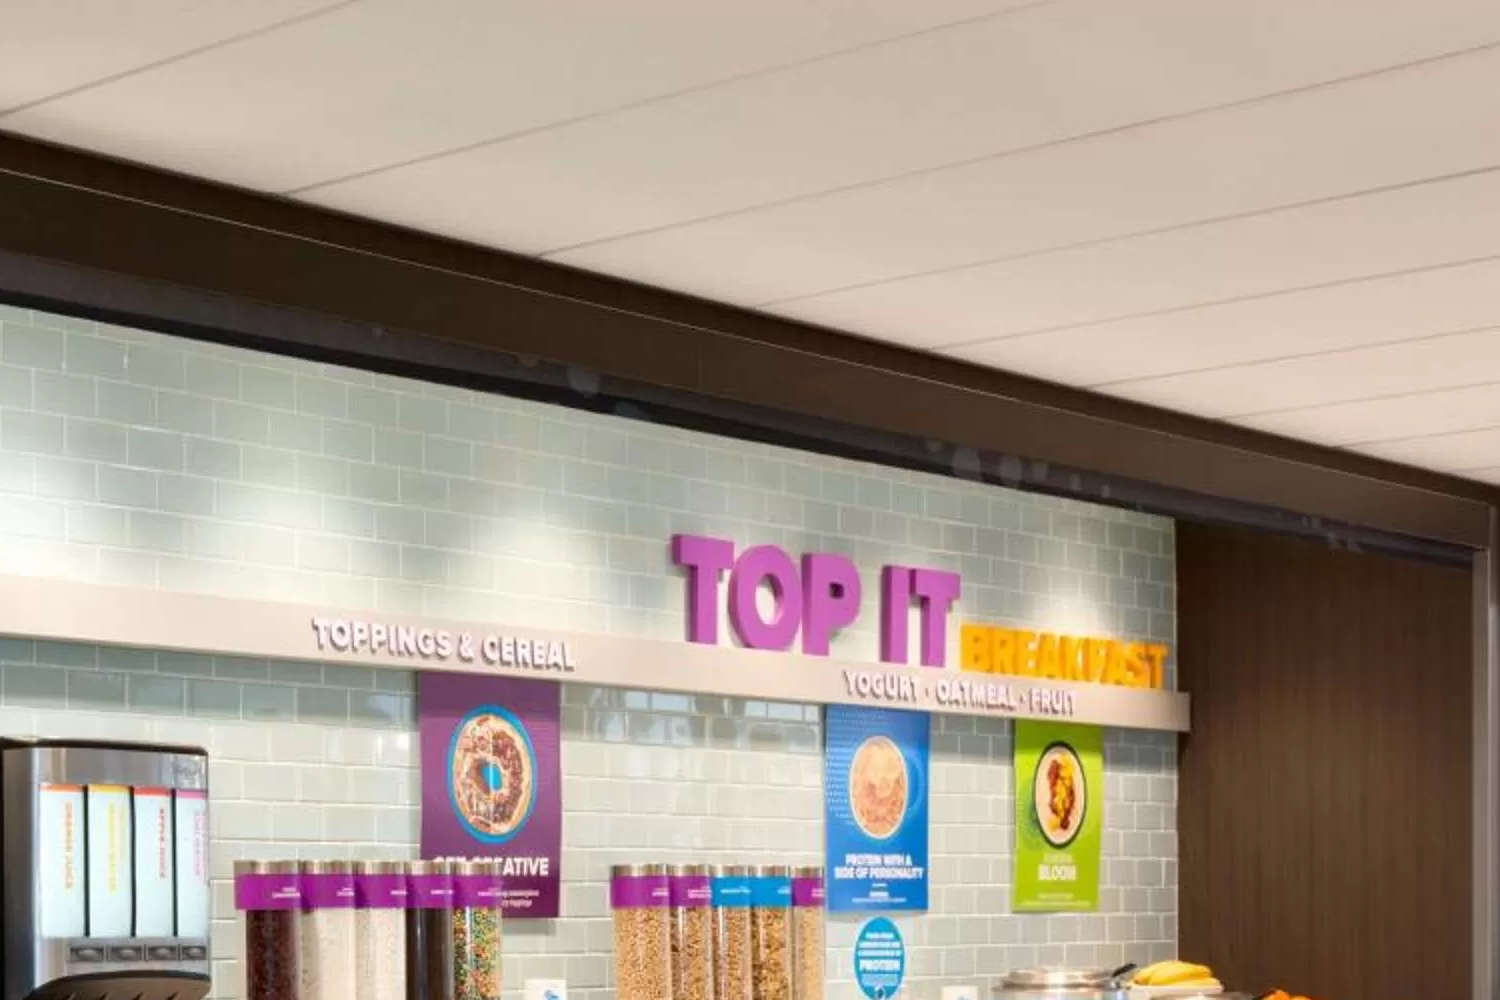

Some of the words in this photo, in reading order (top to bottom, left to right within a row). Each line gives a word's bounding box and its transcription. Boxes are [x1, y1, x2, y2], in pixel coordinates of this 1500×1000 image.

[671, 533, 861, 657] TOP
[880, 565, 961, 668] IT
[312, 617, 451, 660] TOPPINGS
[458, 632, 474, 663] &
[483, 635, 575, 672] CEREAL
[961, 624, 1167, 689] BREAKFAST
[843, 669, 918, 703] YOGURT
[935, 679, 1016, 711] OATMEAL
[1028, 687, 1076, 716] FRUIT
